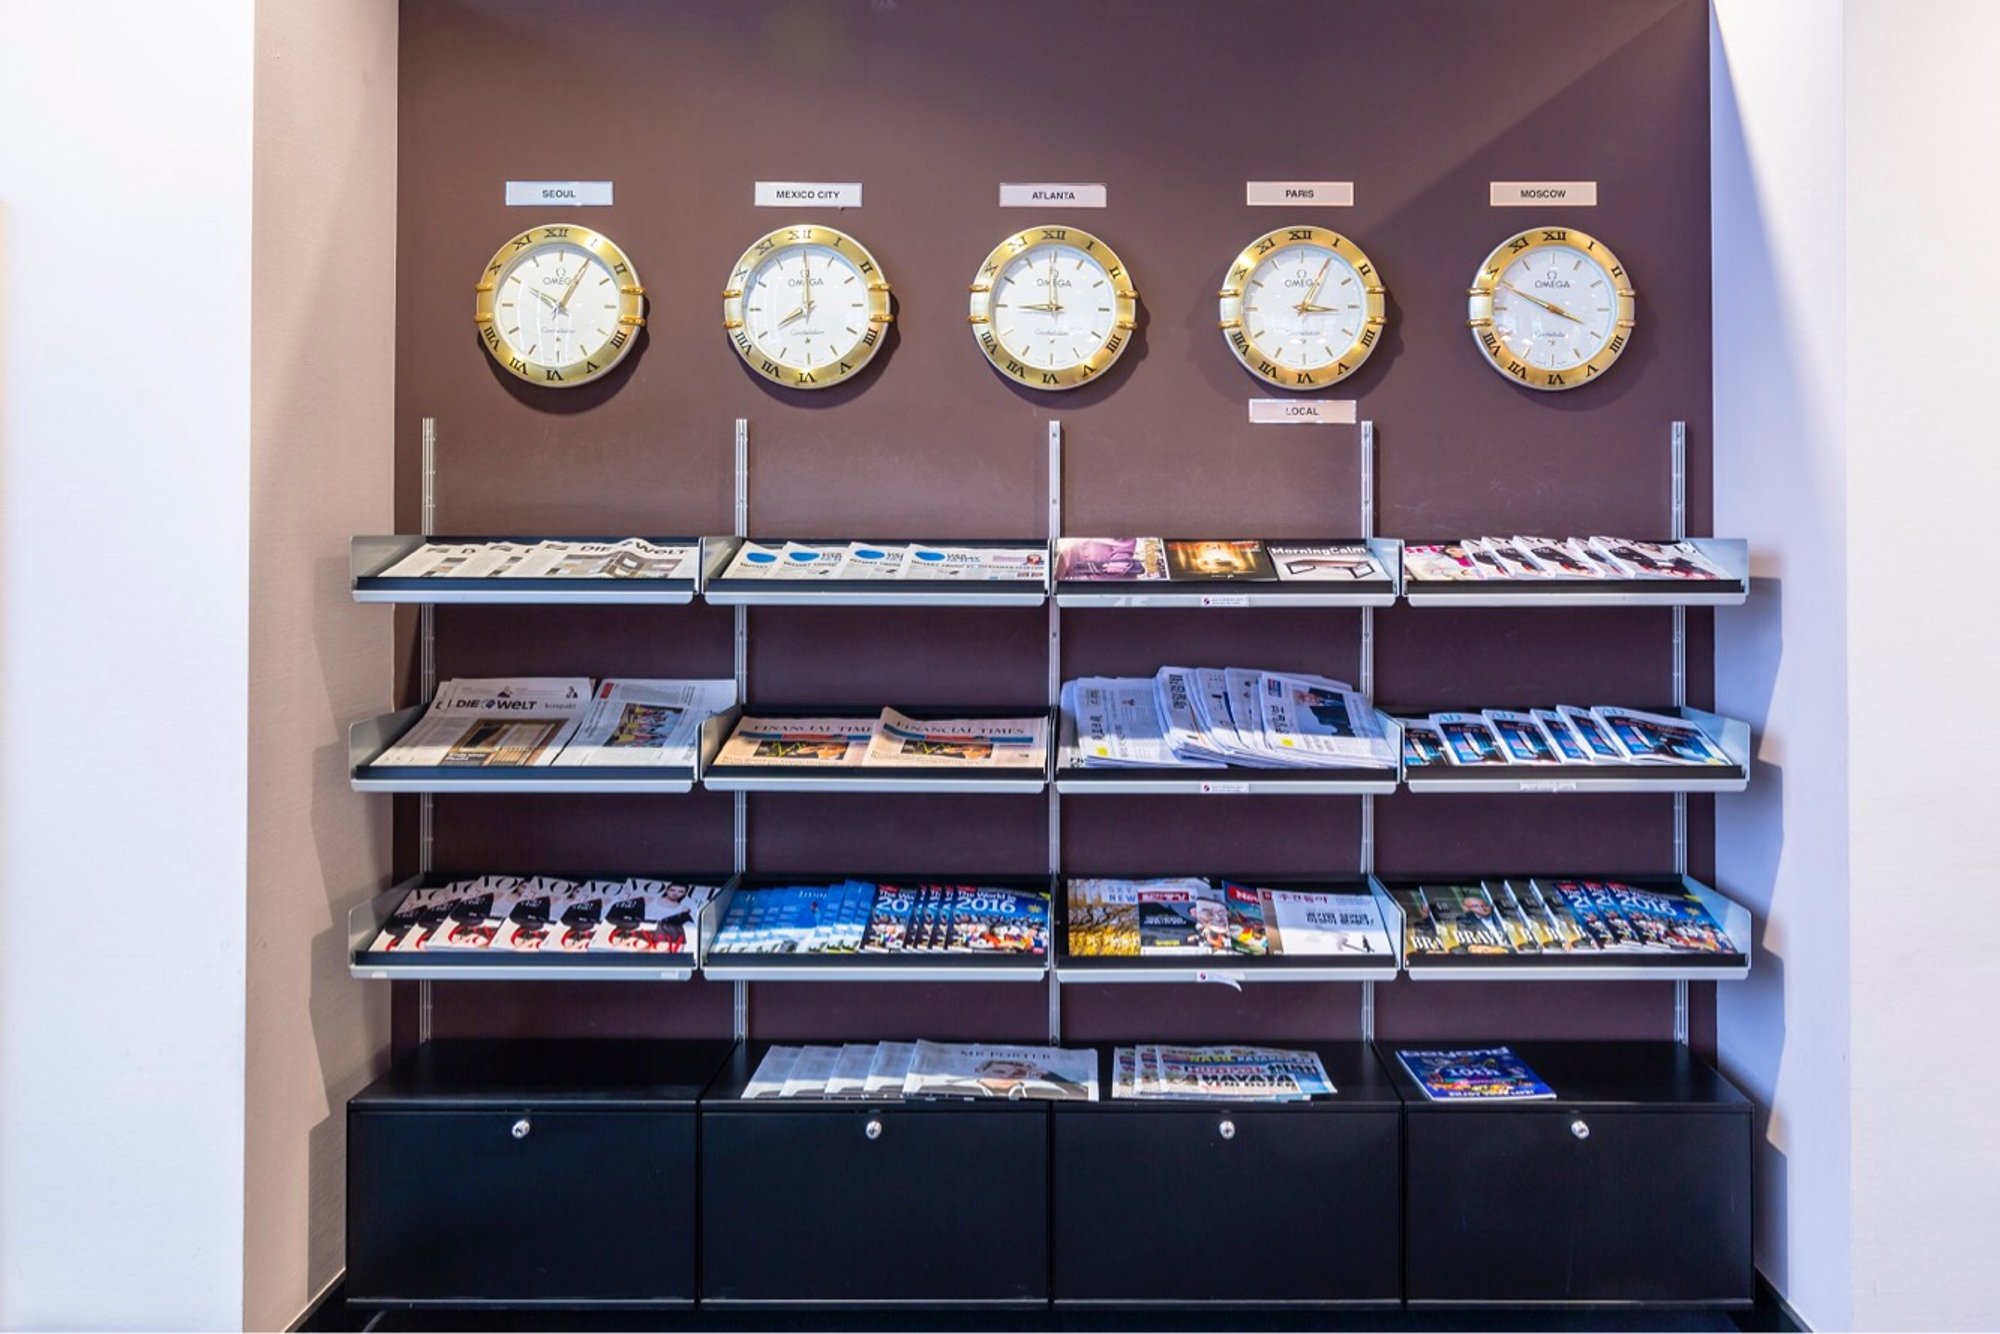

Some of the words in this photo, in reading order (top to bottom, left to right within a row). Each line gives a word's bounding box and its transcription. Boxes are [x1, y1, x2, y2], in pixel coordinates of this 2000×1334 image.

[542, 190, 576, 198] SEOUL
[776, 190, 815, 199] MEXICO
[817, 191, 840, 199] CITY
[1032, 191, 1076, 200] ATLANTA
[1285, 189, 1314, 199] PARIS
[1520, 190, 1566, 199] MOSCOW
[543, 276, 579, 285] OMEG
[1286, 407, 1319, 416] LOCAL
[456, 700, 480, 708] DIE
[896, 722, 972, 733] FINANCIAL
[958, 890, 975, 898] The
[976, 891, 1006, 900] World
[956, 898, 1016, 913] 2016
[1616, 893, 1677, 916] 2016
[1454, 930, 1508, 945] BRAVE
[1402, 1047, 1510, 1058] beyond
